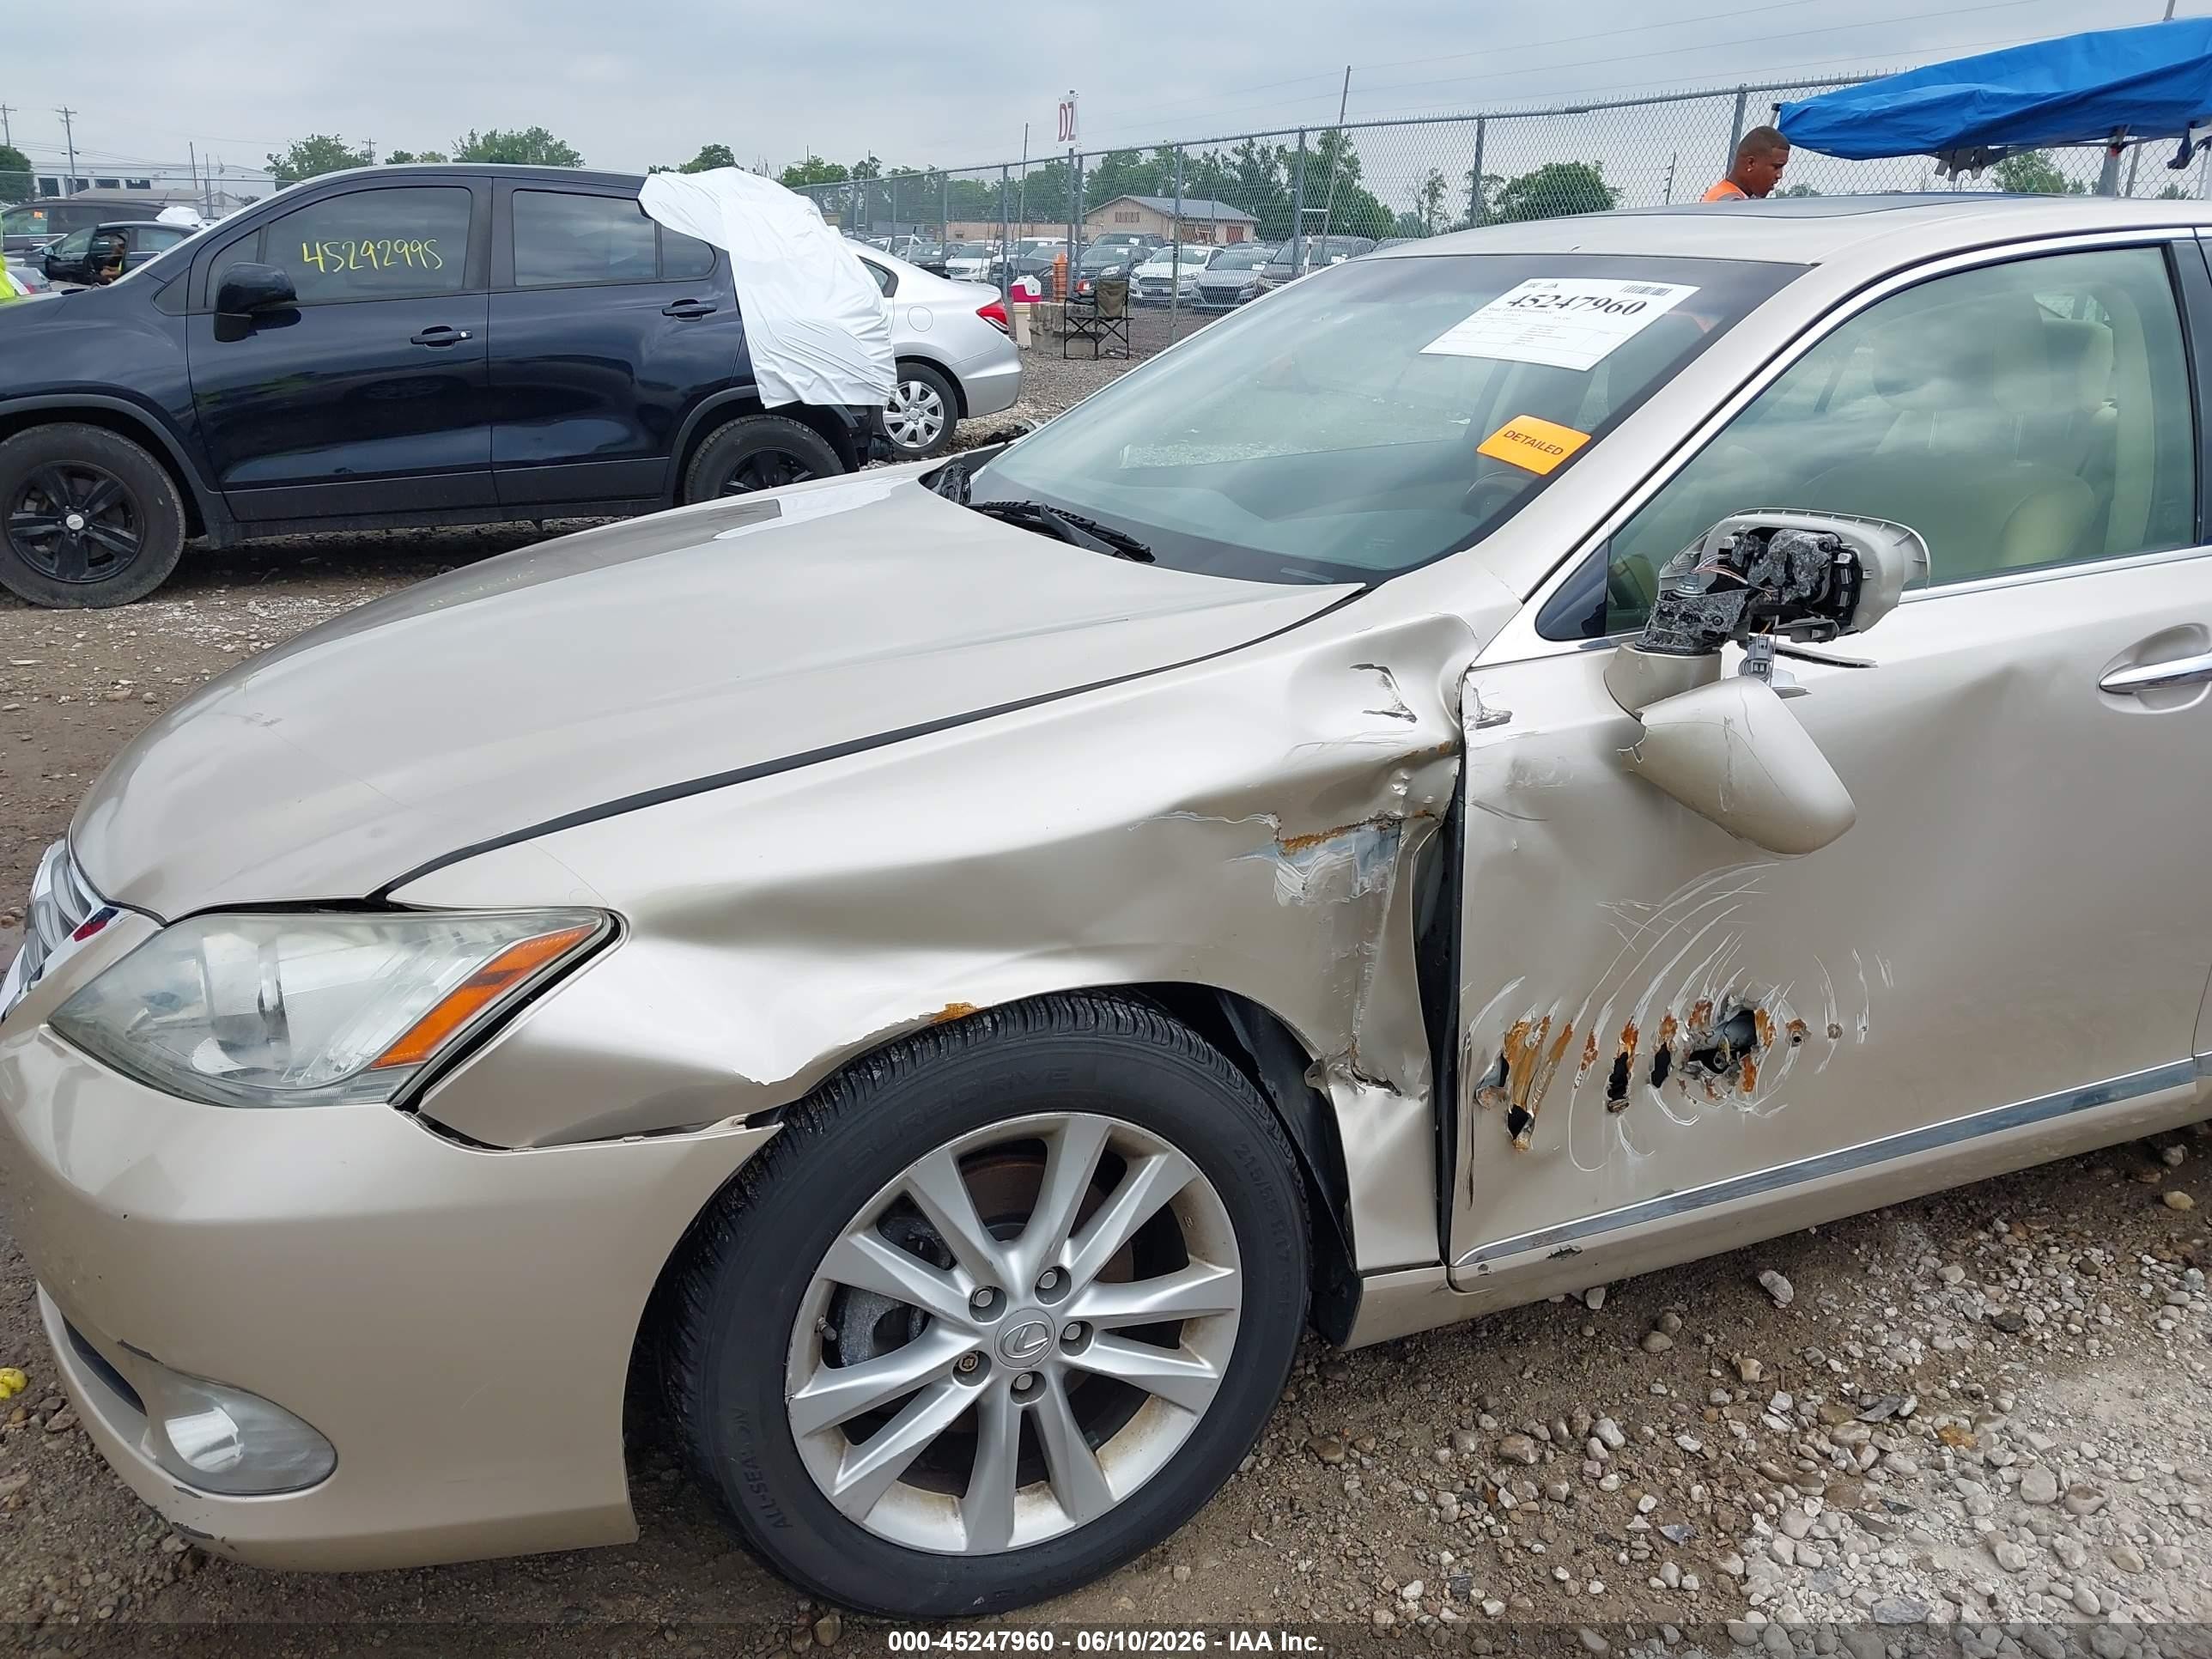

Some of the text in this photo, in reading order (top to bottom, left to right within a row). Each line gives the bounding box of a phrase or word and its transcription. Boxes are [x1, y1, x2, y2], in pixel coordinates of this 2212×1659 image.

[302, 239, 443, 273] 45292995
[1507, 294, 1649, 317] 45247960
[1503, 429, 1564, 456] DETAILED
